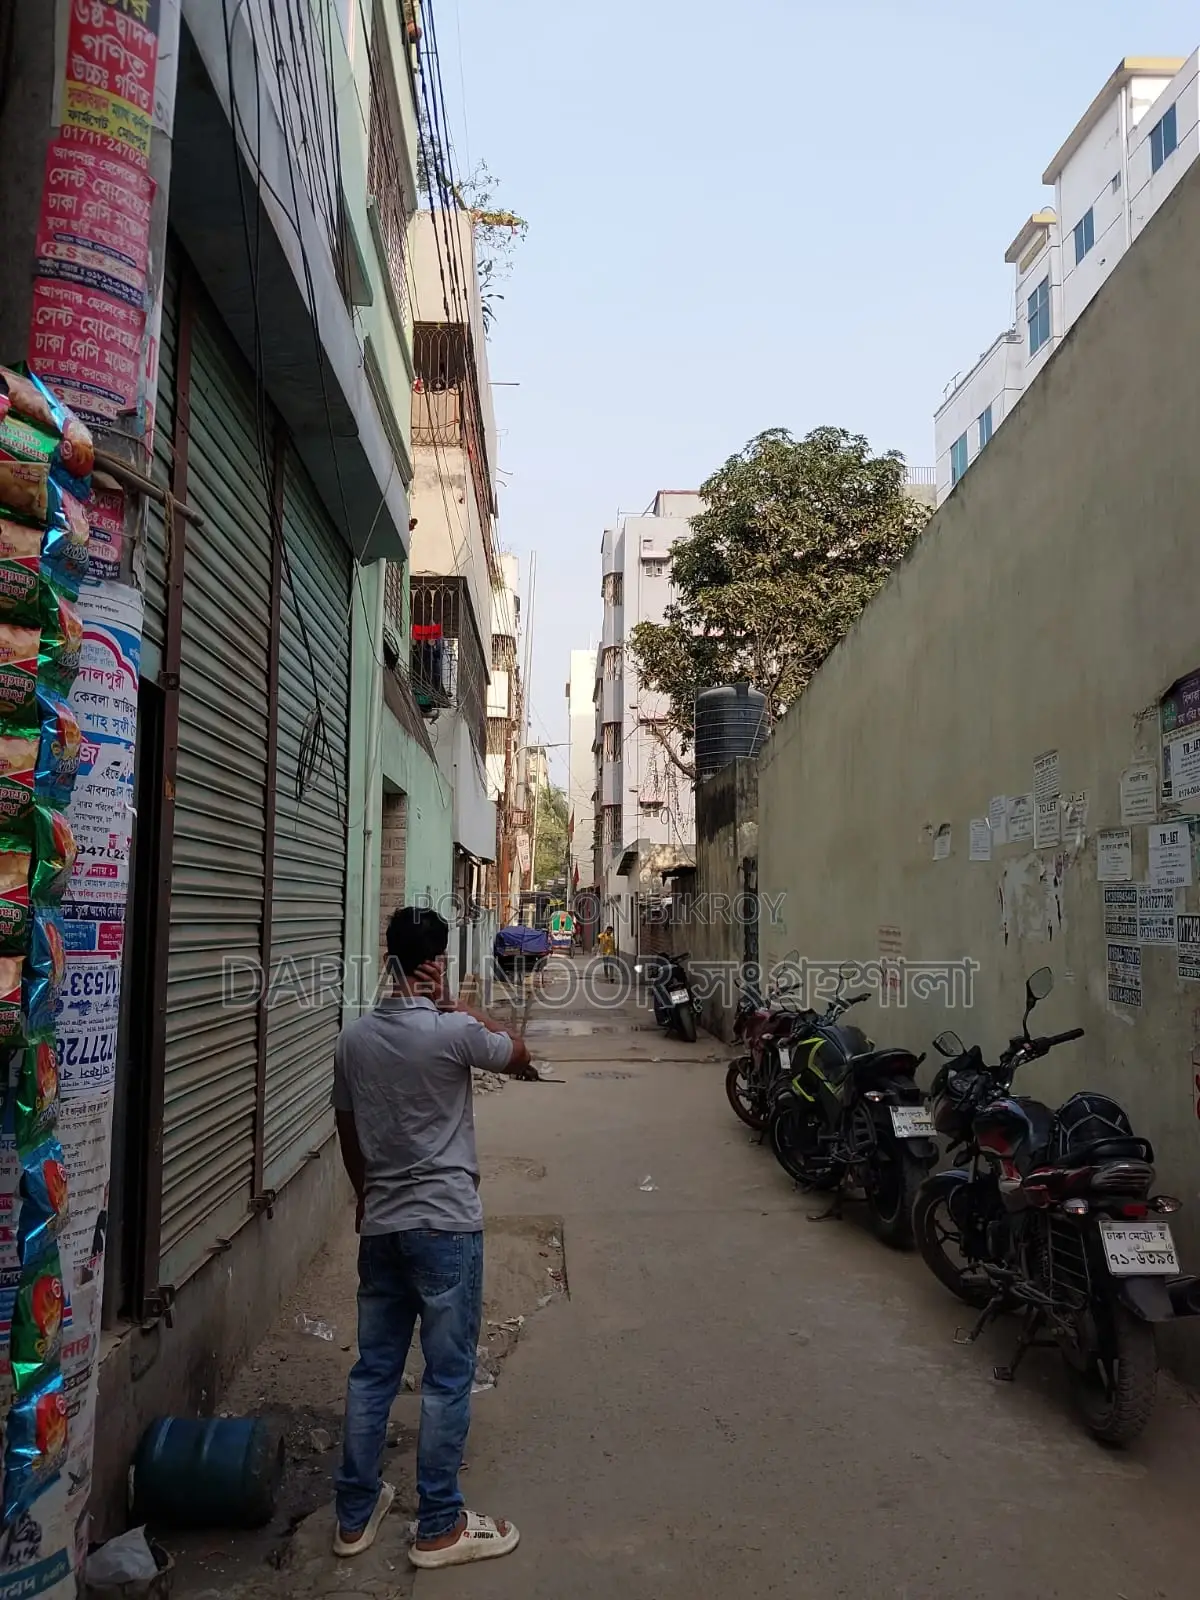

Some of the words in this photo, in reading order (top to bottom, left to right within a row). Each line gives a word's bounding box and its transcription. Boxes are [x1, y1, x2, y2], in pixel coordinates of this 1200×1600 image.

[81, 33, 149, 78] গণিত
[47, 193, 78, 215] ঢাকা
[35, 333, 65, 355] ঢাকা
[74, 691, 109, 708] কেবলা
[1106, 1231, 1126, 1241] ঢাকা
[1110, 1253, 1175, 1265] ৭১-৬৩৯৫
